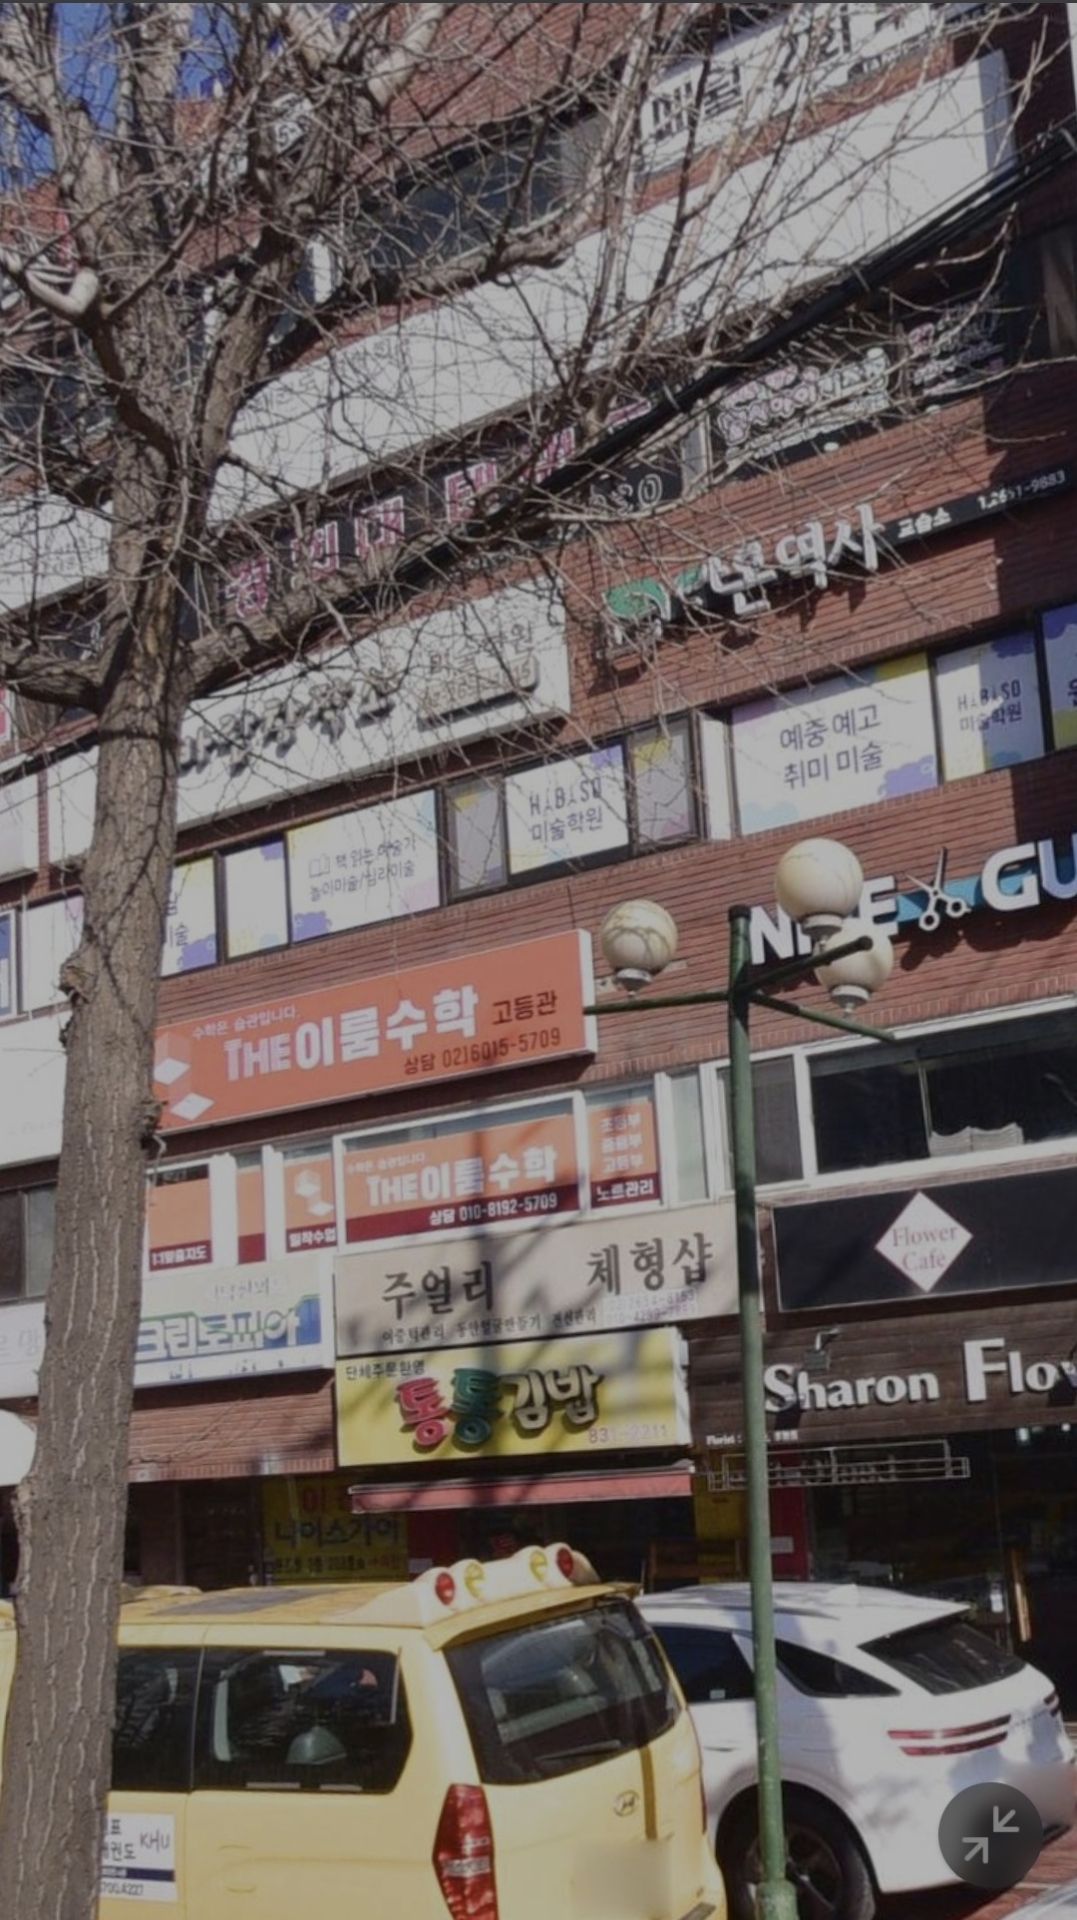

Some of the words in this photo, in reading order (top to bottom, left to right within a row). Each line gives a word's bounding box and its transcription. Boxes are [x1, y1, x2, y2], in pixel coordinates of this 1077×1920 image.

[898, 507, 952, 538] 교습소
[780, 717, 827, 750] 예중
[832, 704, 881, 736] 예고
[959, 701, 1022, 731] 미술학원
[783, 754, 830, 789] 취미
[836, 740, 884, 774] 미술
[531, 807, 603, 842] 미술학원
[492, 990, 558, 1026] 고등관
[192, 1021, 228, 1040] 수학은
[404, 1053, 436, 1075] 상담
[442, 1028, 561, 1069] 02)6015-5709
[597, 1179, 654, 1202] 노트관리
[429, 1210, 455, 1226] 상담
[459, 1192, 557, 1221] 010-8192-5709
[892, 1225, 958, 1248] Flower
[382, 1260, 495, 1320] 주얼리
[586, 1231, 713, 1296] 체형샵
[345, 1359, 426, 1380] 단체주문환영
[764, 1364, 940, 1413] Sharon
[139, 1829, 171, 1854] KHU
